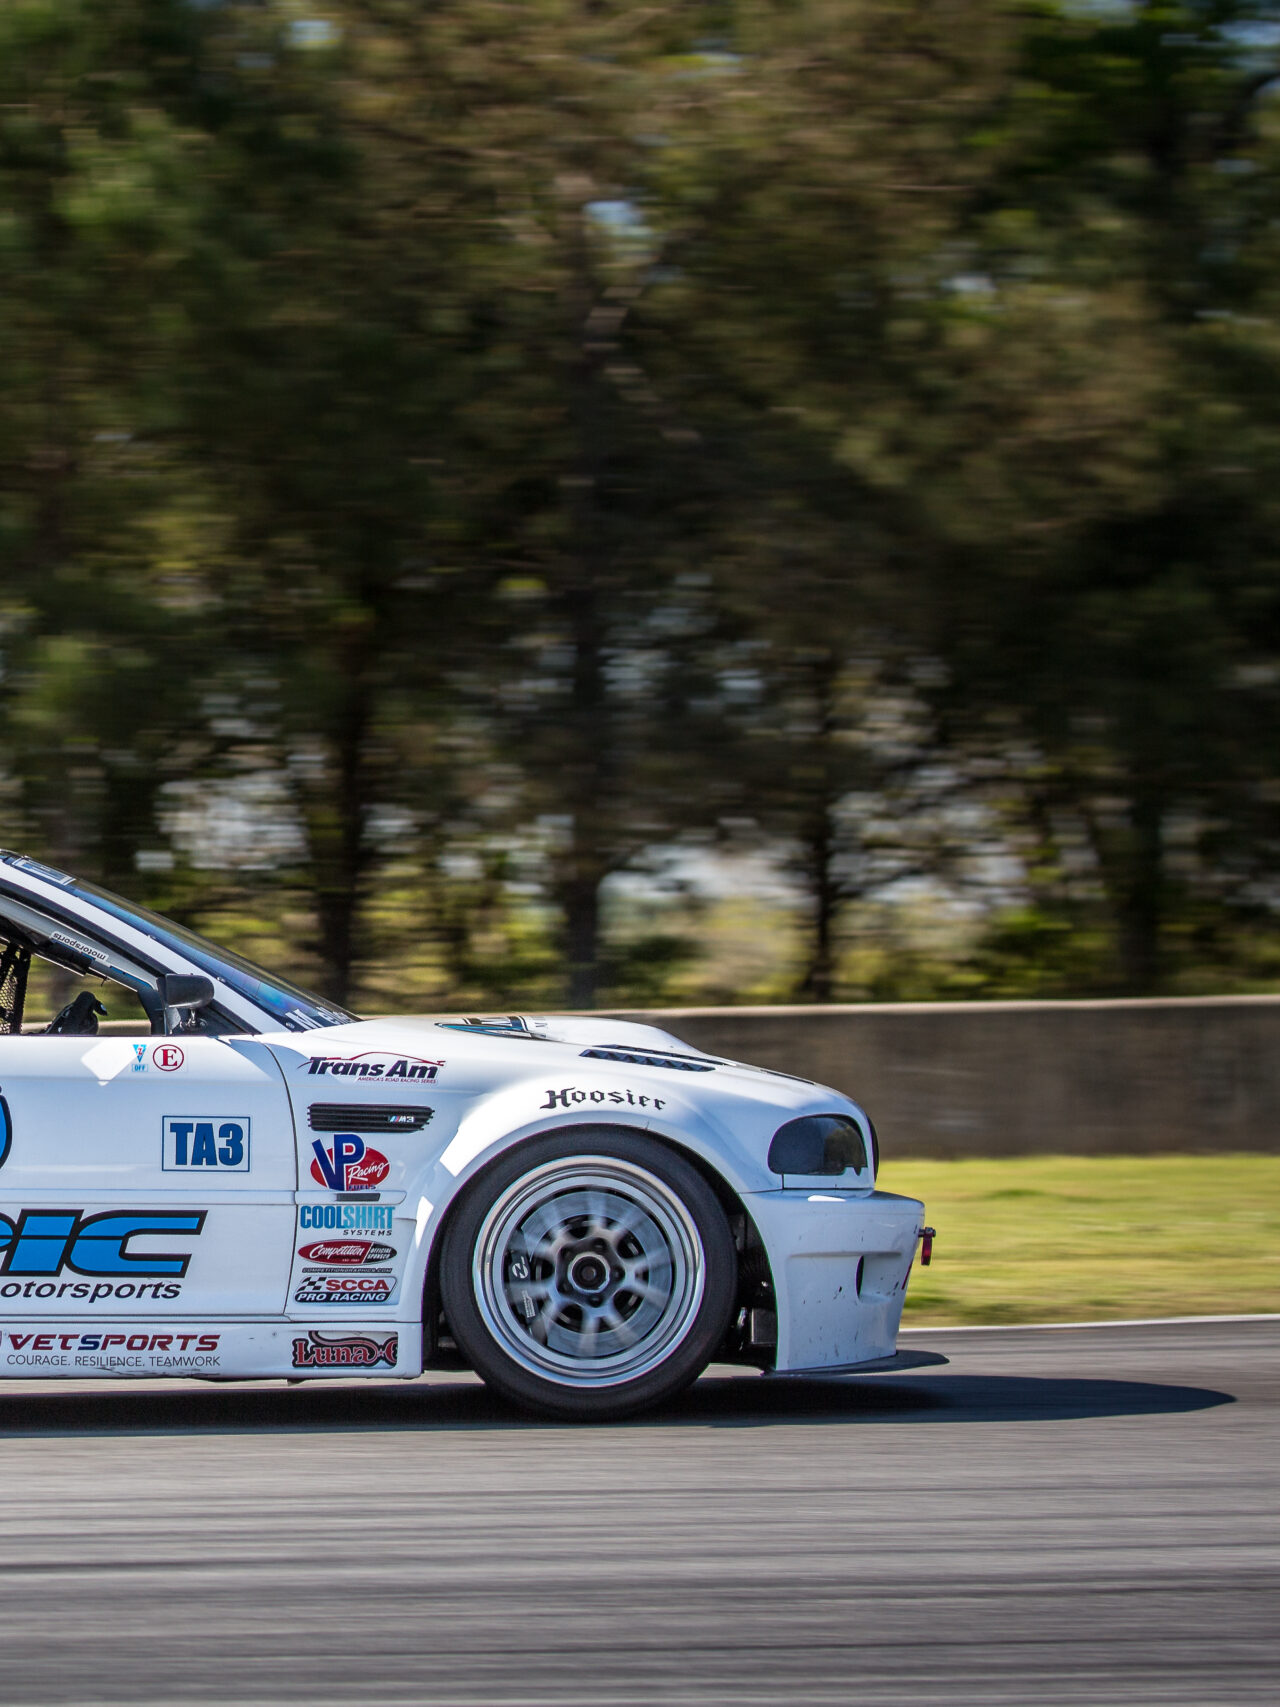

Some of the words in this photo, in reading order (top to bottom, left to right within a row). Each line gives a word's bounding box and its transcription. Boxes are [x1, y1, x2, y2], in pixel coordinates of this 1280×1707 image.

[53, 932, 106, 960] motorsports
[160, 1048, 178, 1067] E
[308, 1056, 385, 1076] Trans
[385, 1060, 438, 1079] Am
[539, 1087, 666, 1110] Hoosier
[170, 1122, 245, 1167] TA3
[311, 1133, 365, 1191] VP
[347, 1161, 390, 1184] Racing
[300, 1205, 395, 1229] COOLSHIRT
[309, 1244, 365, 1259] Competition
[326, 1279, 390, 1291] SCCA
[297, 1293, 327, 1301] PRO
[330, 1293, 387, 1301] RACING
[8, 1334, 221, 1351] VETSPORTS
[7, 1354, 71, 1366] COURAGE.
[75, 1355, 145, 1367] RESILIENCE.
[149, 1356, 221, 1367] TEAMWORK
